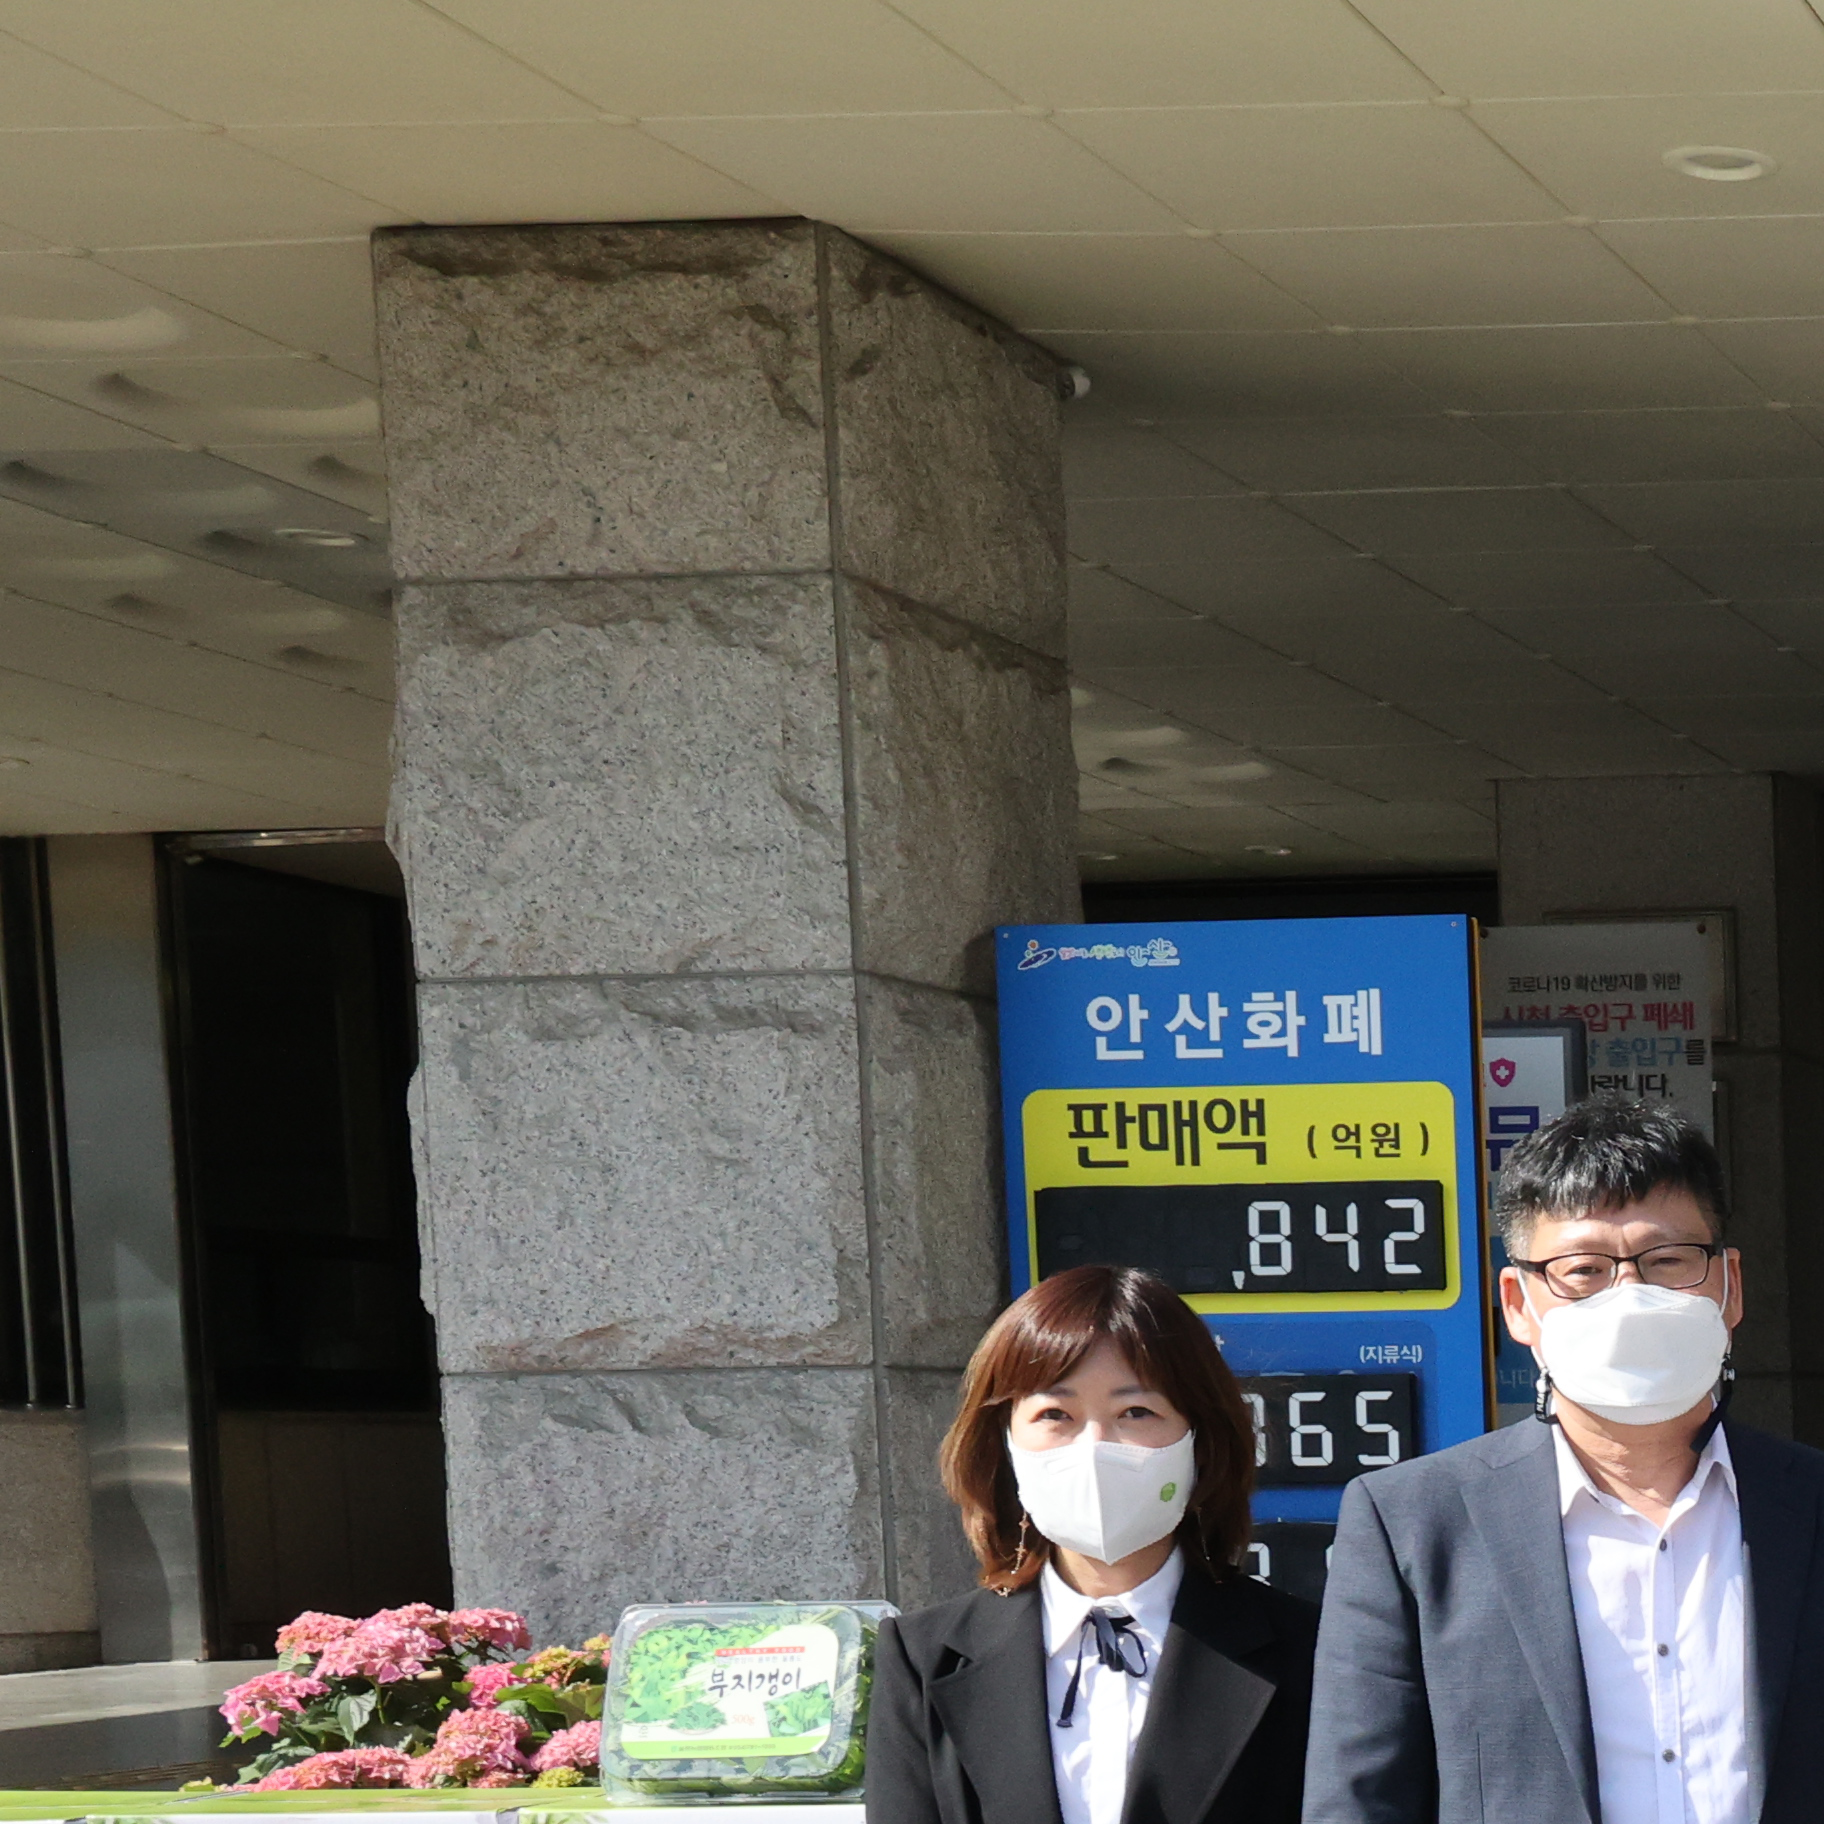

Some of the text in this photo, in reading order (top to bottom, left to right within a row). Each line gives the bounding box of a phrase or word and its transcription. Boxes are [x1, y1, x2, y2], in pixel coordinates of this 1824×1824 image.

[1508, 973, 1681, 993] 코로나19 확산방지를 위한
[1643, 1001, 1695, 1031] 폐쇄
[1606, 1037, 1706, 1067] 출입구를
[1068, 1099, 1266, 1168] 판매액
[1360, 1344, 1423, 1363] (지류식)
[708, 1667, 801, 1698] 부지갱이
